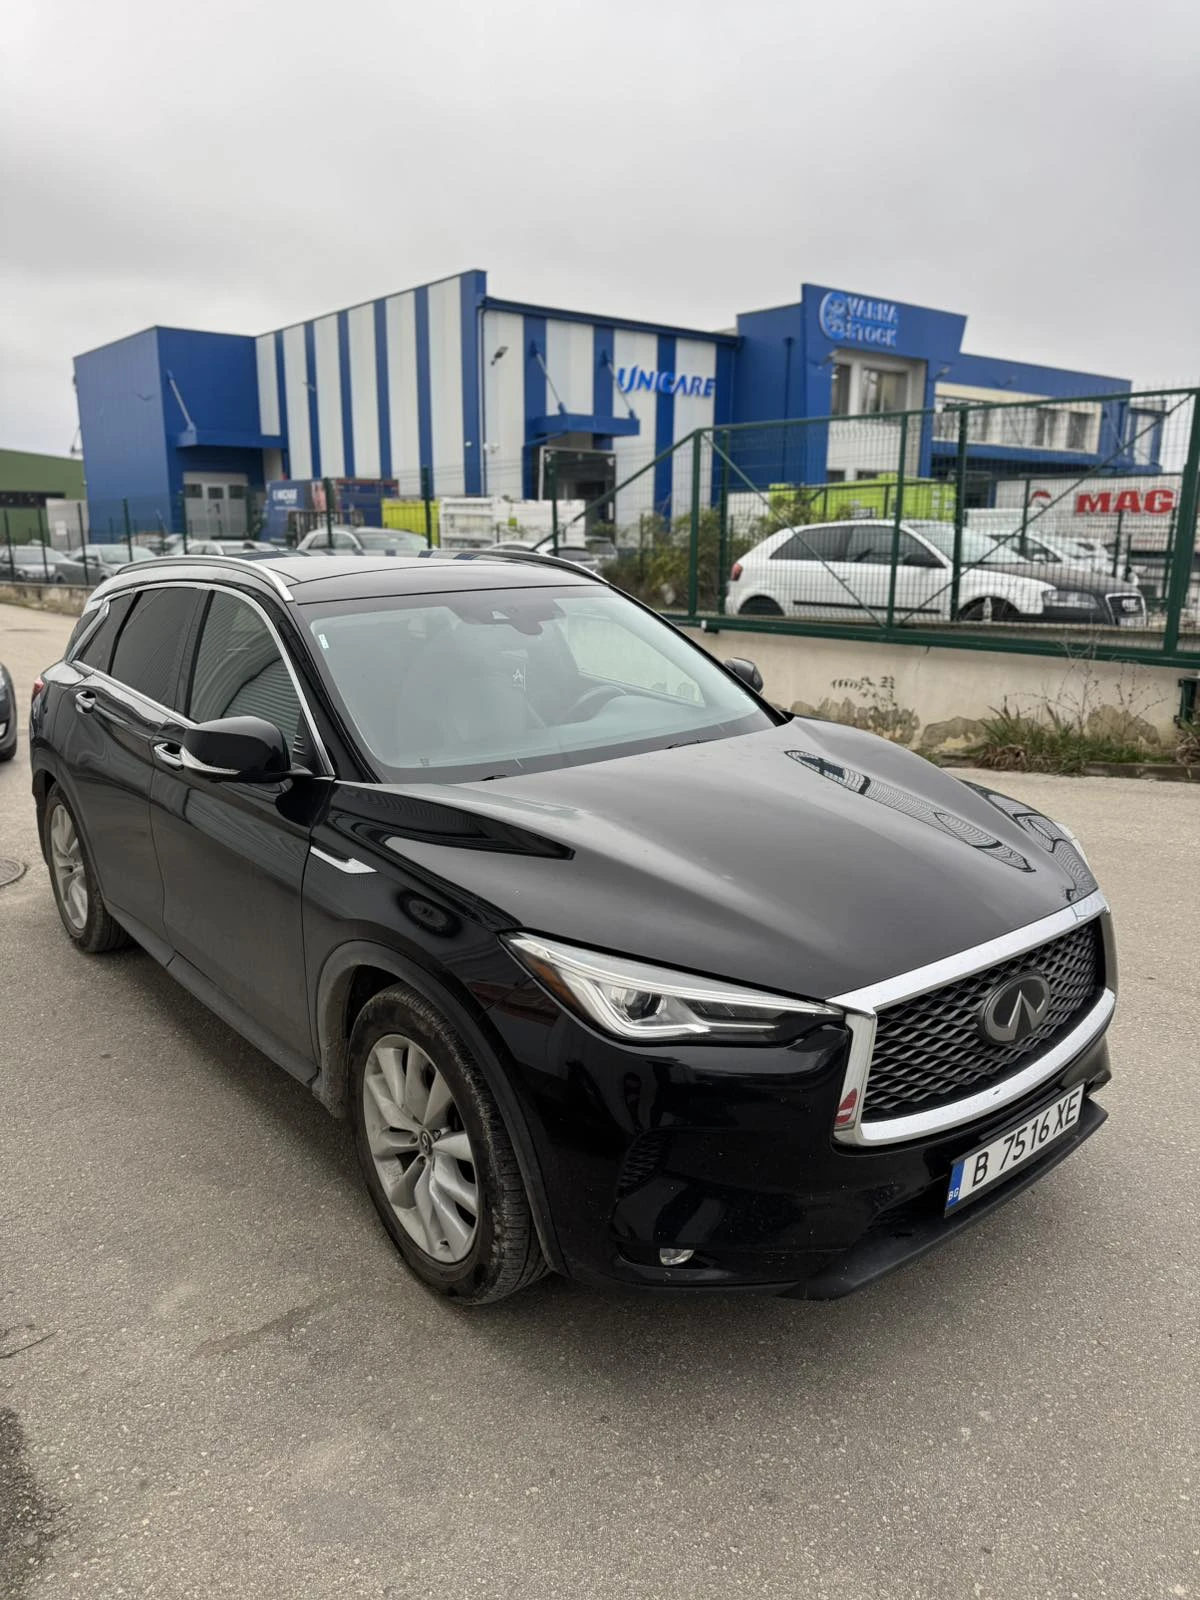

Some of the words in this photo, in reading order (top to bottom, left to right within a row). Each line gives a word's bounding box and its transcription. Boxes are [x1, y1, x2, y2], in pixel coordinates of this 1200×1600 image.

[617, 364, 716, 398] UNICARE
[1075, 490, 1175, 514] MAG
[972, 1151, 990, 1187] B
[1000, 1111, 1051, 1171] 7516
[1053, 1091, 1080, 1135] XE
[948, 1187, 960, 1201] BG
